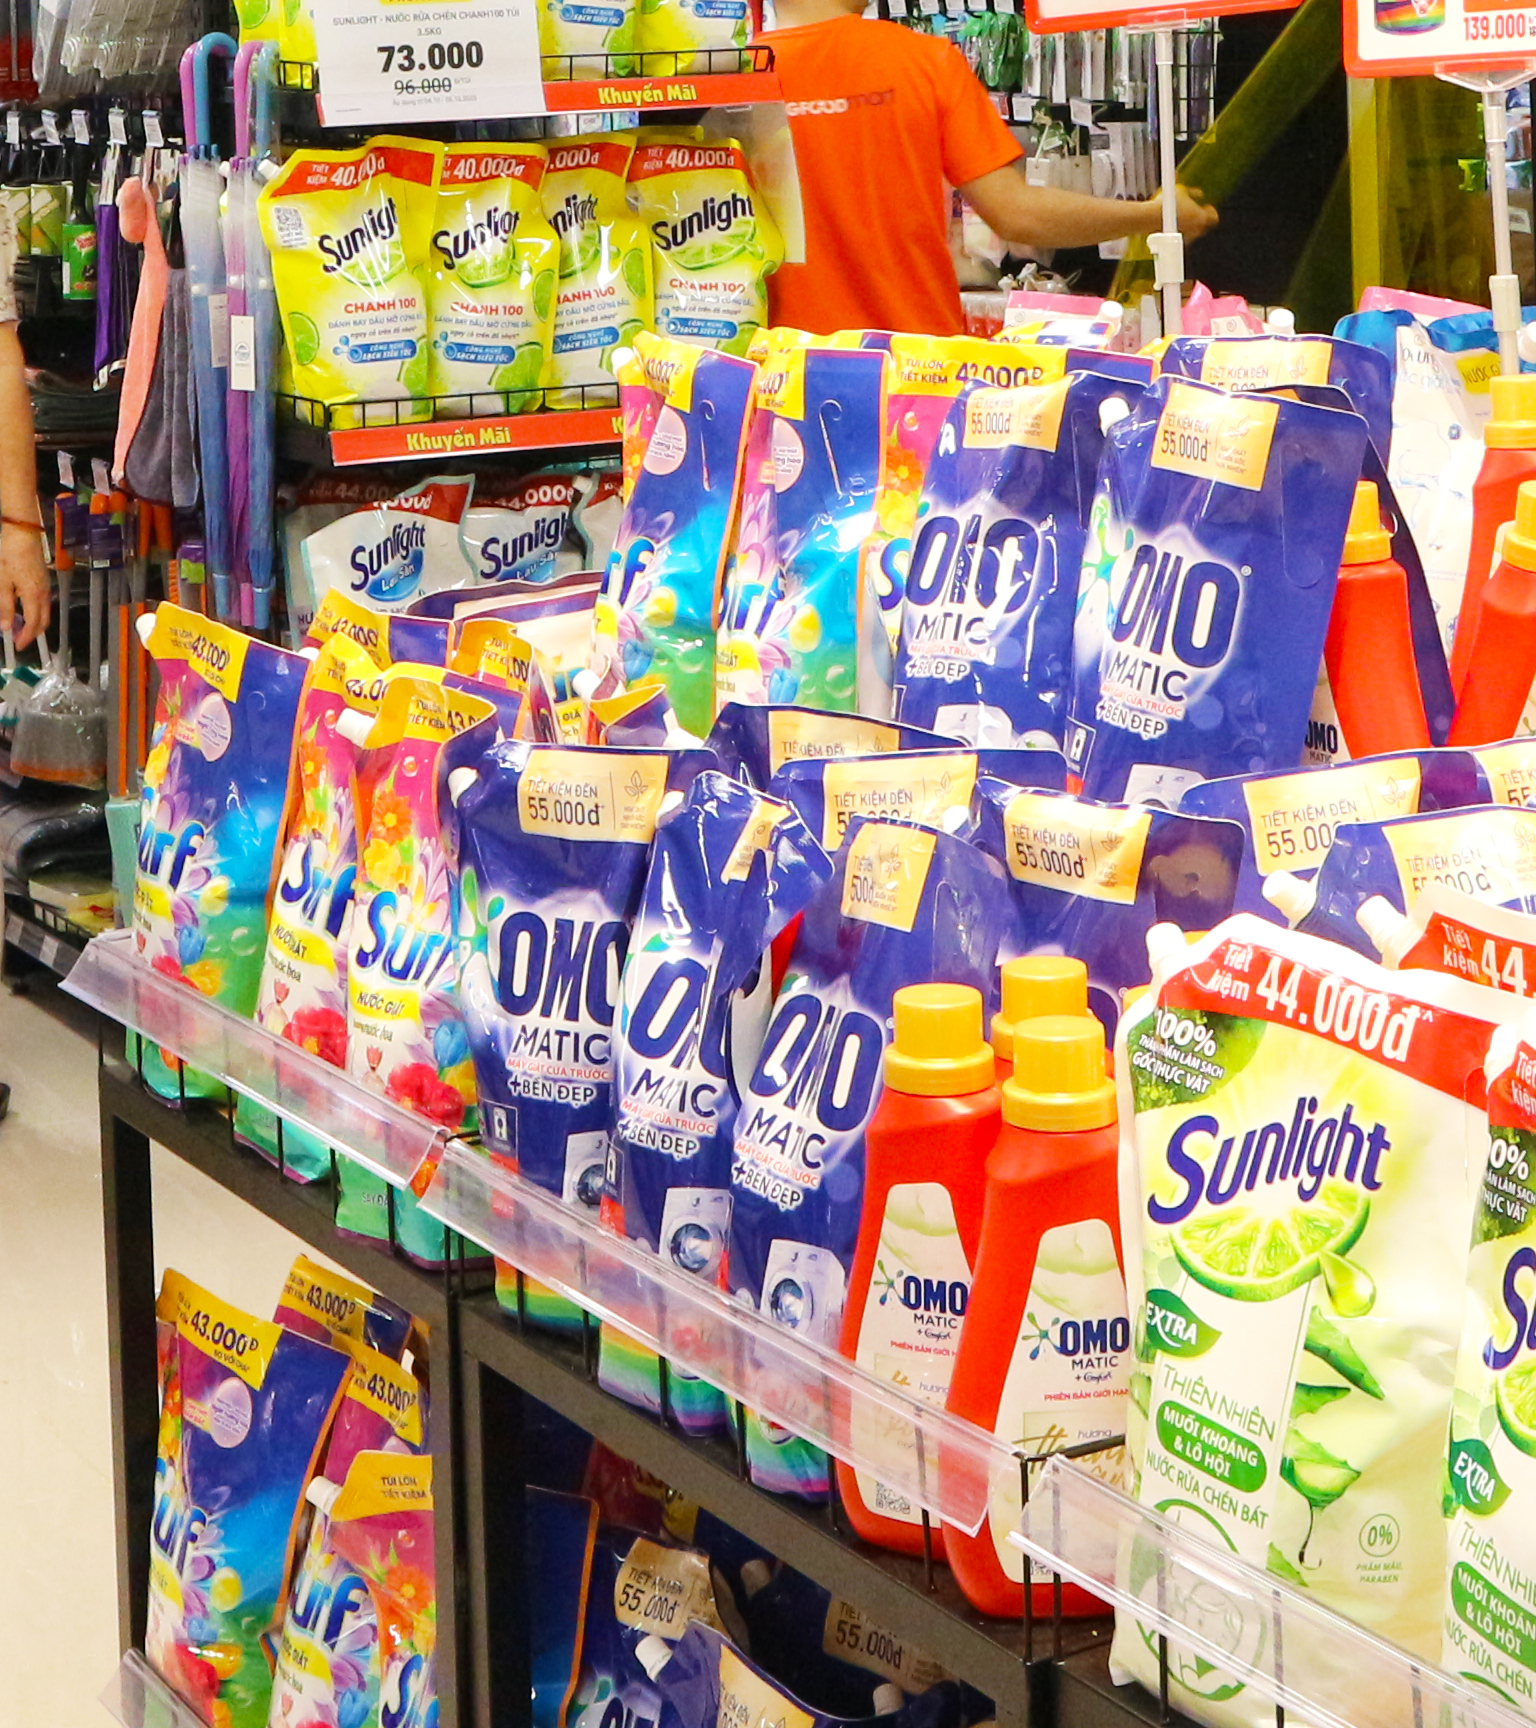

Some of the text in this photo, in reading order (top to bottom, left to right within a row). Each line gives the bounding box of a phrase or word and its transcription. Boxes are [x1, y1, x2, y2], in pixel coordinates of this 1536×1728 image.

[1464, 13, 1525, 42] 139.000
[377, 41, 484, 73] 73.000
[394, 77, 452, 95] 96.000
[598, 84, 697, 107] Khuyến Mãi
[651, 192, 755, 252] Sunlight
[406, 425, 512, 453] Khuyến Mãi
[1113, 544, 1240, 668] OMO
[1108, 651, 1188, 701] MATIC
[528, 797, 600, 826] 55.000đ
[511, 1025, 609, 1065] MATIC
[1154, 1003, 1217, 1060] 100%
[1148, 1096, 1391, 1225] Sunlight
[903, 1276, 970, 1316] OMO
[1059, 1317, 1130, 1357] OMO
[1146, 1303, 1198, 1345] EXTRA
[1163, 1365, 1276, 1442] THIÊN NHIÊN
[1367, 1524, 1392, 1547] 0%
